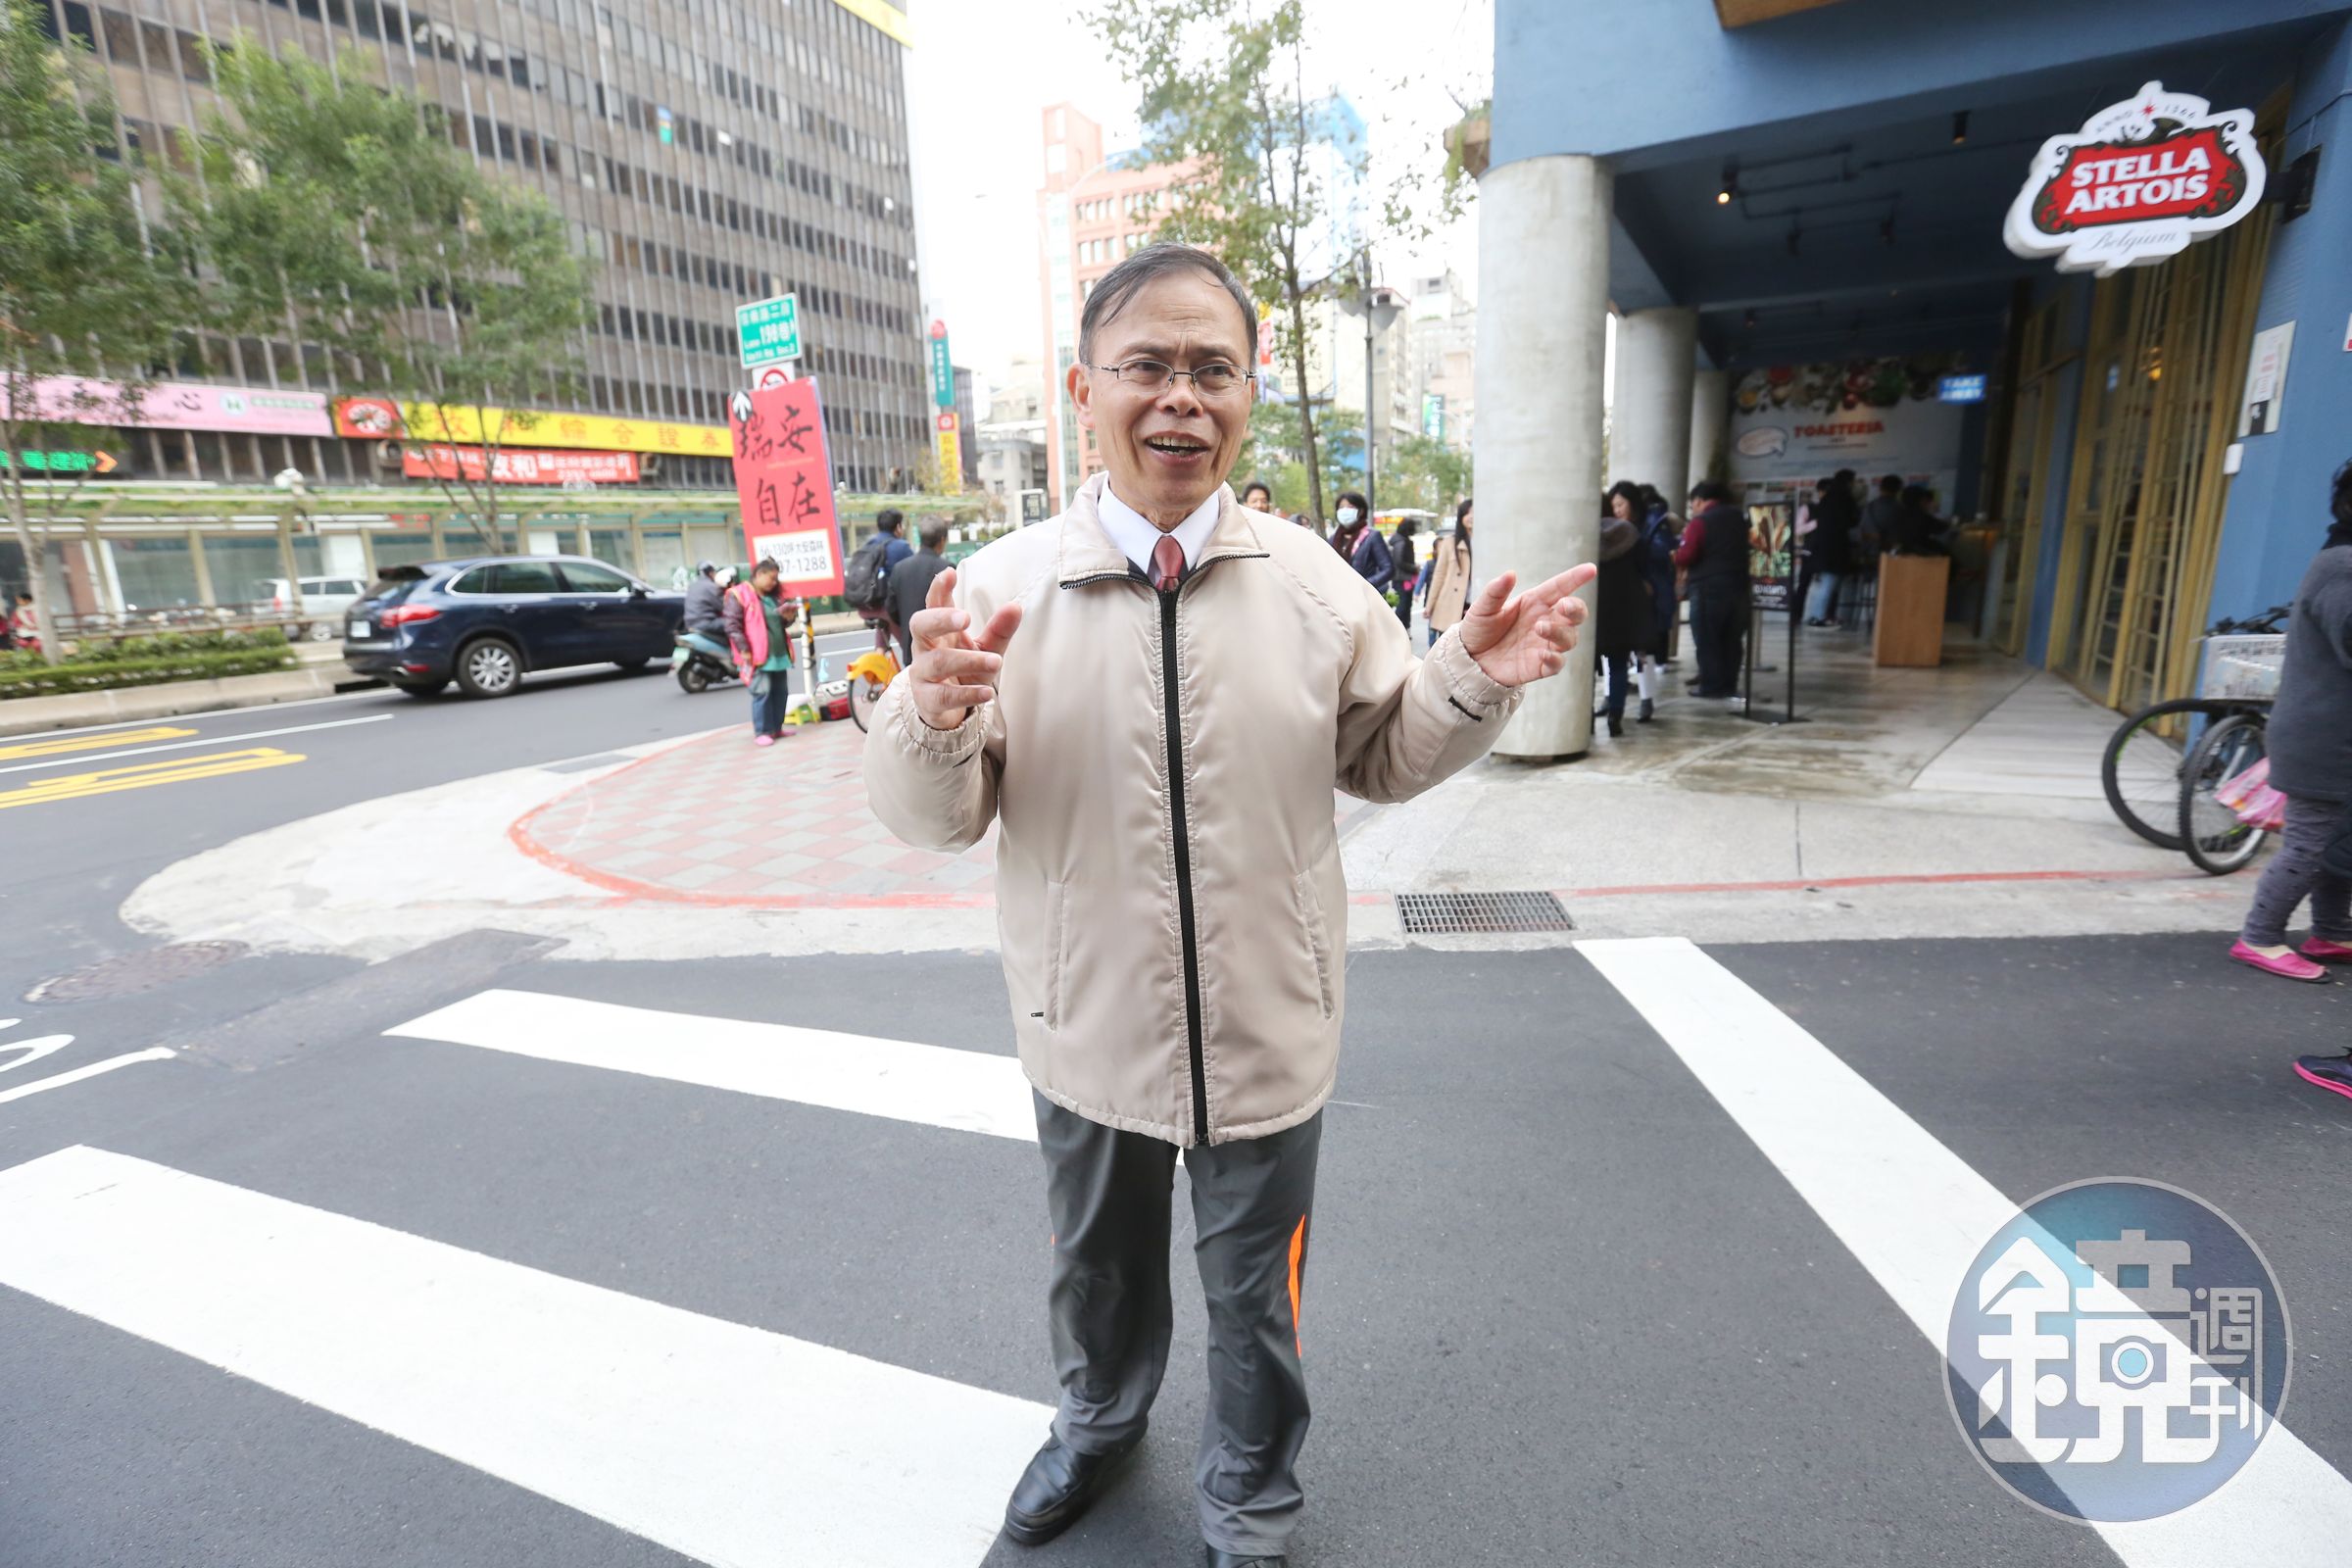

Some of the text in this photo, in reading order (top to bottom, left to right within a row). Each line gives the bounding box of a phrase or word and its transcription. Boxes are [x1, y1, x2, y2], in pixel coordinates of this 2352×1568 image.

[2070, 146, 2212, 188] STELLA
[2063, 172, 2209, 216] ARTOIS
[2086, 227, 2179, 256] Belgium
[755, 470, 821, 526] 自在
